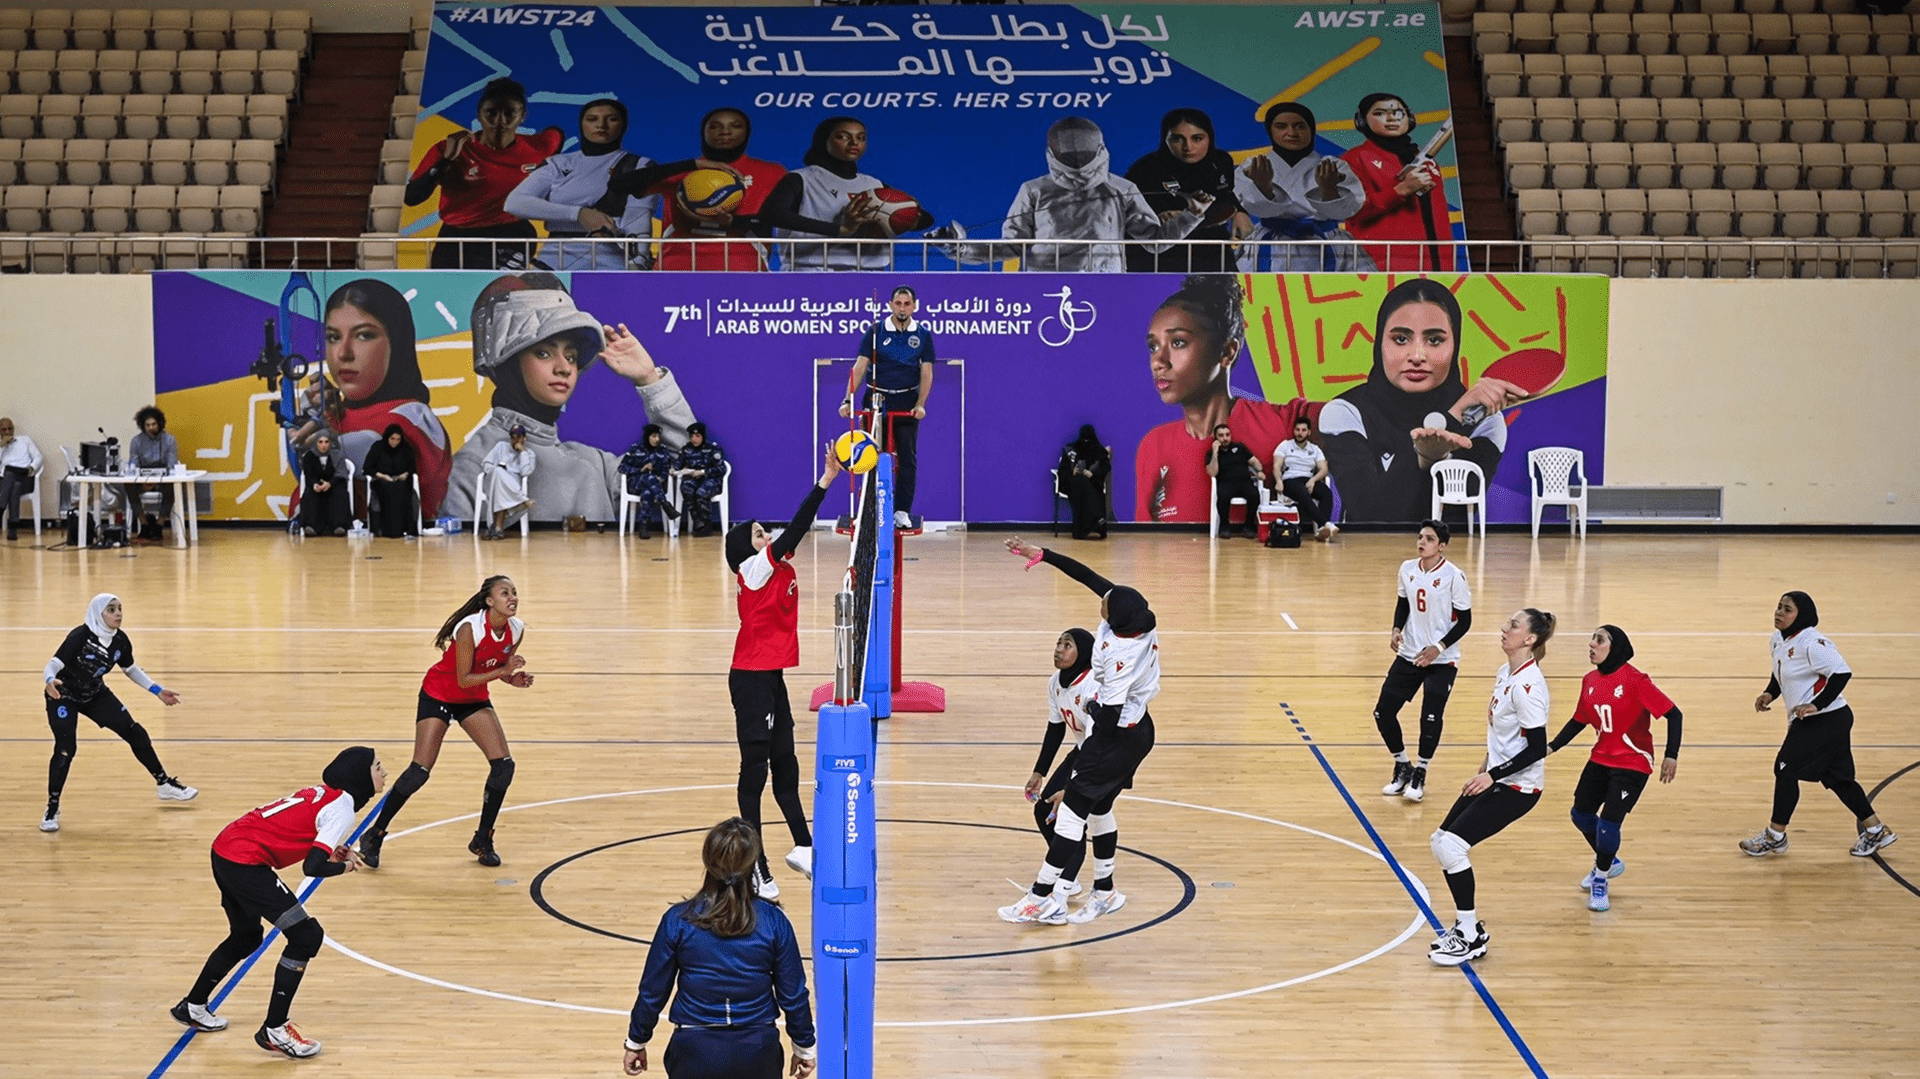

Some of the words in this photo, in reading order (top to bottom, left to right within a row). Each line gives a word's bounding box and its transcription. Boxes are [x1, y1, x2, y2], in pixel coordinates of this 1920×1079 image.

[448, 9, 596, 27] #AWST24
[1294, 11, 1426, 28] AWST.ae
[705, 14, 901, 49] حكاية
[912, 13, 1070, 49] بطلة
[1082, 14, 1170, 49] لكل
[698, 49, 955, 85] الملاعب
[965, 49, 1172, 85] ترويها
[754, 92, 815, 108] OUR
[822, 92, 943, 108] COURTS.
[953, 92, 1010, 108] HER
[1016, 92, 1113, 108] STORY
[717, 298, 795, 317] للسيدات
[800, 297, 859, 317] العربية
[927, 297, 989, 318] الألعاب
[995, 298, 1032, 318] دورة
[663, 304, 702, 333] 7th
[715, 319, 760, 335] ARAB
[764, 319, 833, 335] WOMEN
[838, 319, 881, 335] SPO
[917, 319, 1033, 335] OURNAMENT
[1416, 588, 1427, 613] 6
[56, 705, 69, 719] 6
[1593, 703, 1613, 734] 10
[847, 788, 859, 844] Senoh
[831, 946, 860, 954] Senoh
